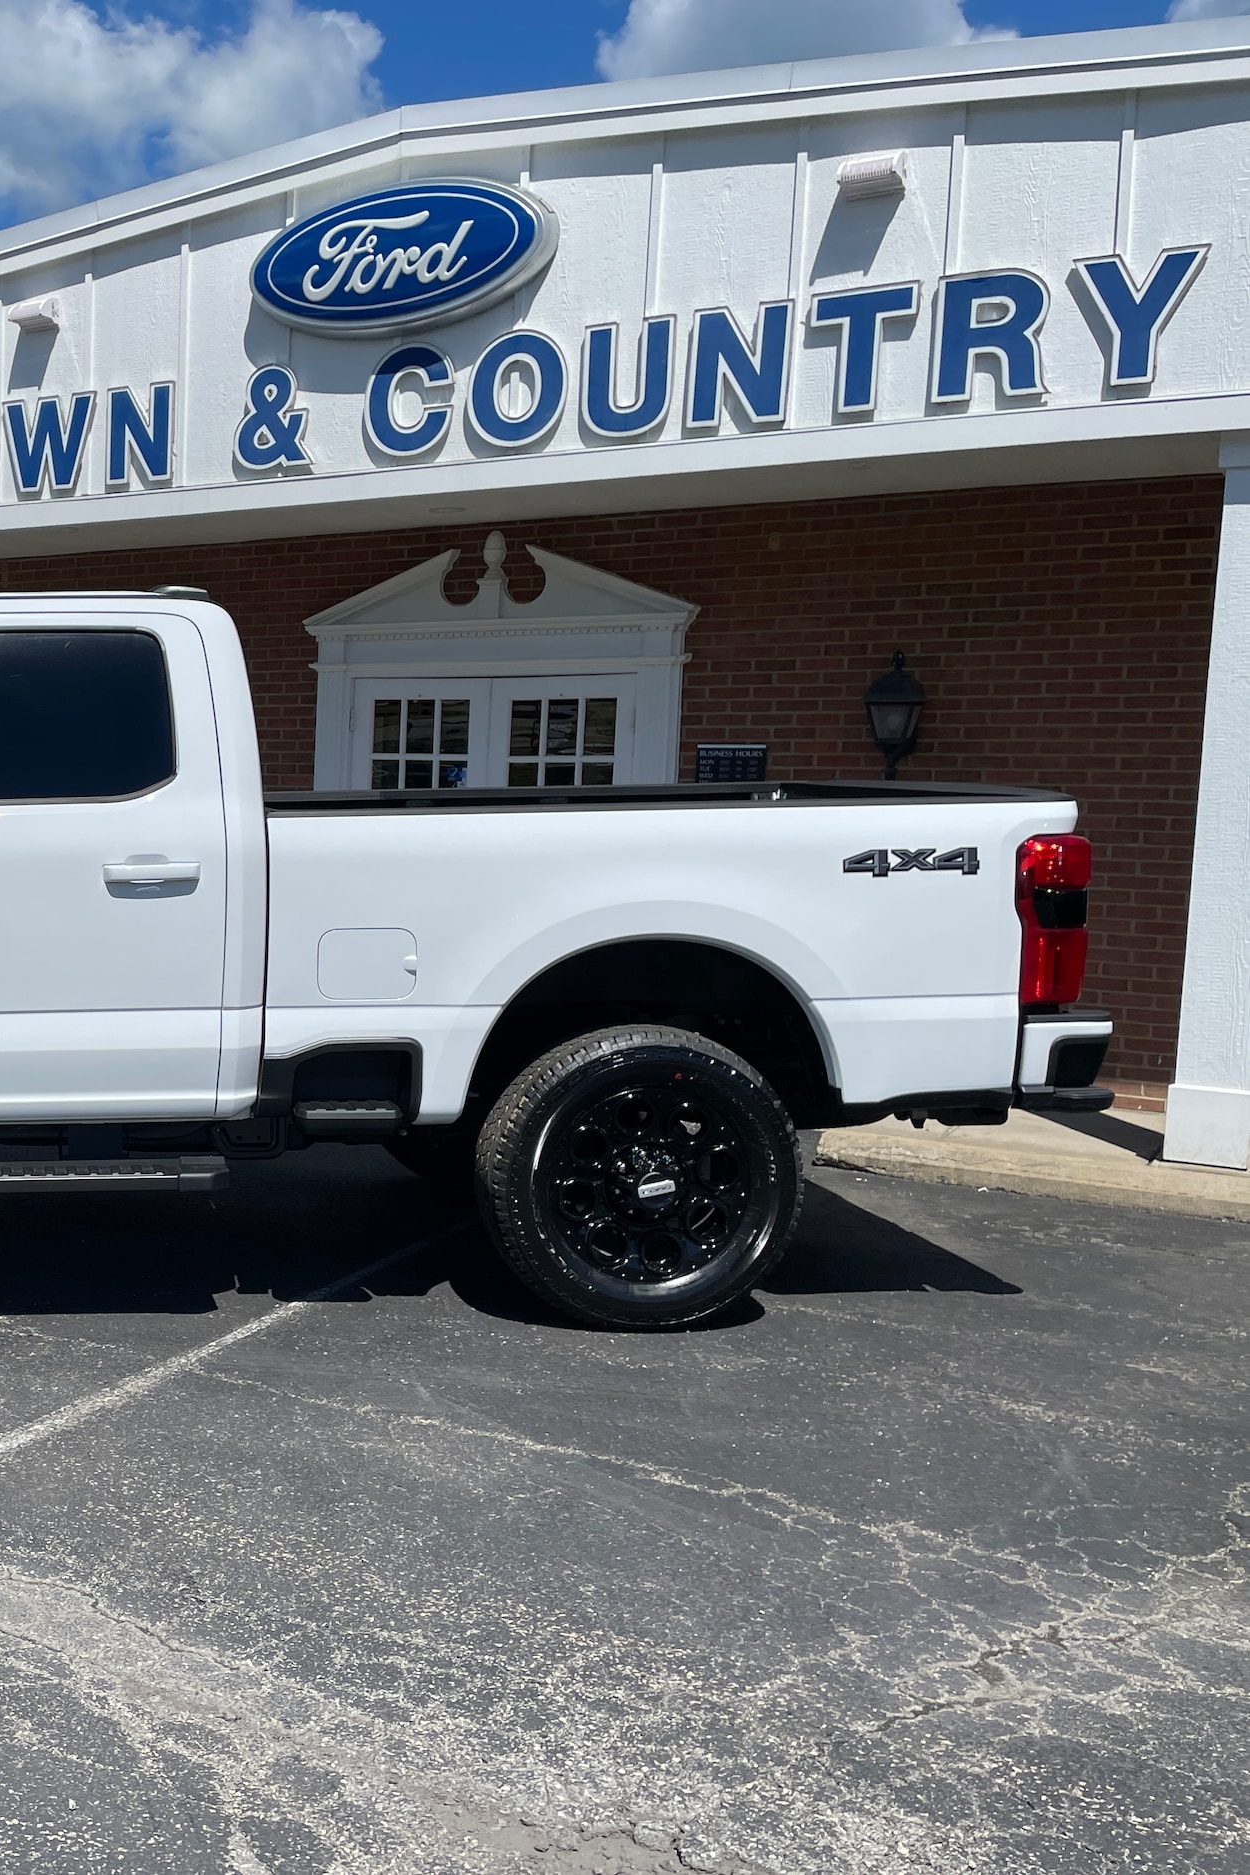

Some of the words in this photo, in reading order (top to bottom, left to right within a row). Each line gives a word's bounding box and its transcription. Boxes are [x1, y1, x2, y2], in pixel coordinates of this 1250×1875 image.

[302, 209, 474, 302] Ford
[234, 364, 314, 472] &
[364, 243, 1212, 457] COUNTRY
[735, 749, 763, 757] HOURS
